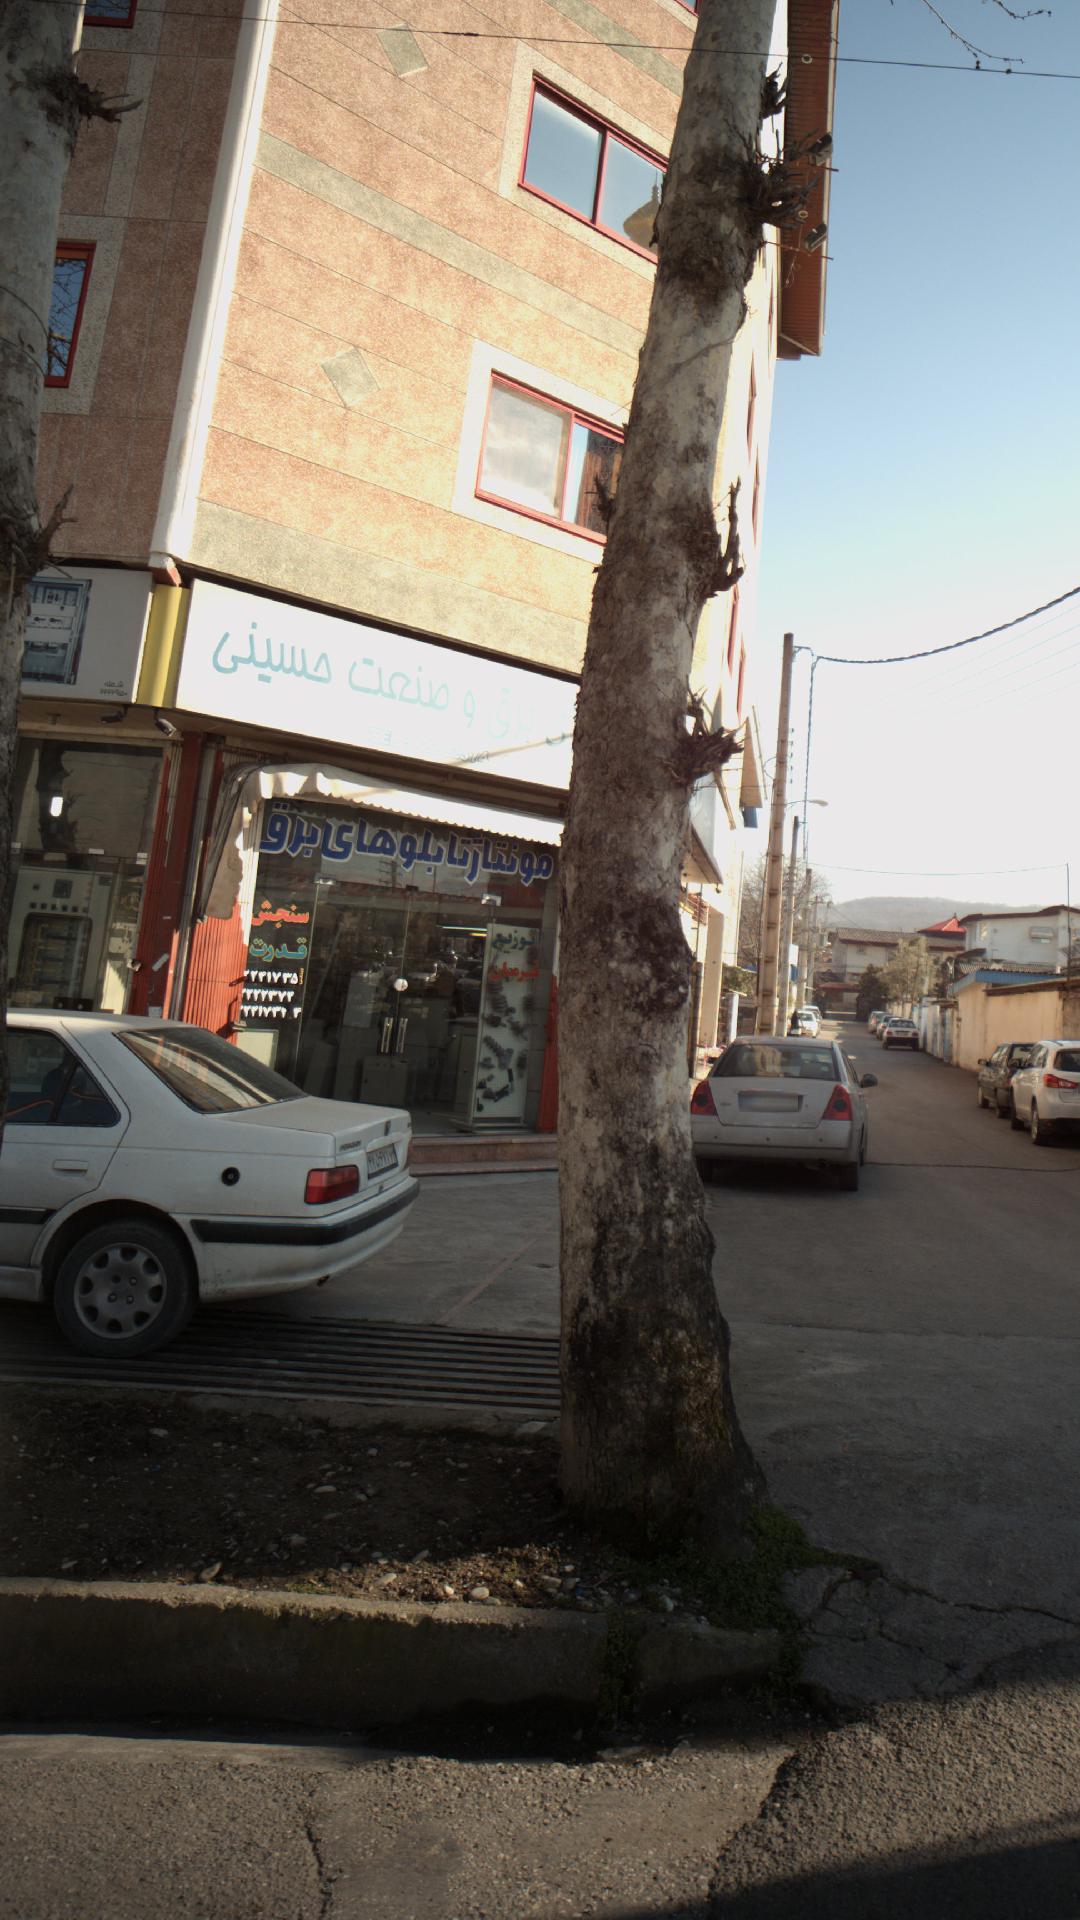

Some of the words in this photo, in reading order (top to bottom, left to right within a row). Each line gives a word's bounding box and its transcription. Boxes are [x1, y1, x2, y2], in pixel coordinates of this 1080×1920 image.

[212, 621, 332, 685] حسینی
[348, 658, 451, 711] صنعت
[463, 688, 478, 729] و
[259, 801, 322, 858] برق
[251, 900, 310, 928] سنجش
[249, 937, 308, 962] قدرت
